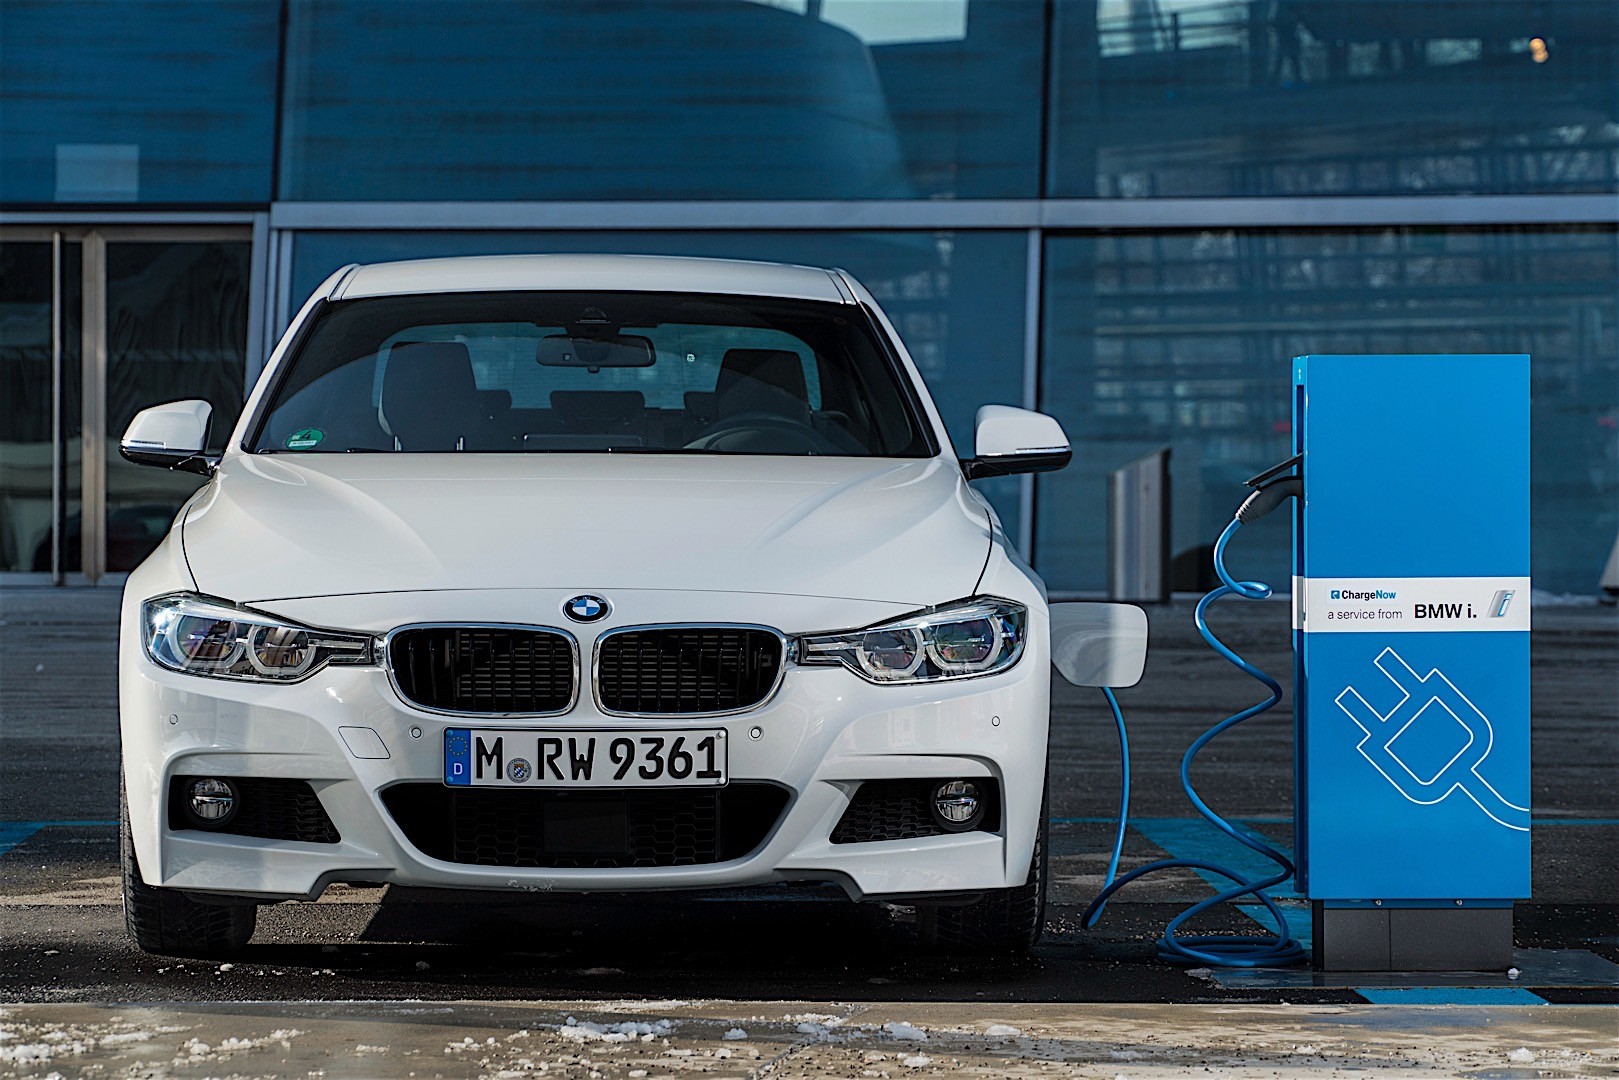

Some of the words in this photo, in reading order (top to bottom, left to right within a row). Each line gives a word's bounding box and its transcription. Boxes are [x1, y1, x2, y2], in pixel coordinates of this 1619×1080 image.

[1341, 590, 1396, 601] ChargeNow
[1327, 611, 1334, 620] a
[1337, 608, 1374, 620] service
[1378, 608, 1402, 620] from
[1414, 603, 1463, 619] BMW
[475, 736, 504, 780] M
[537, 737, 596, 780] RW
[609, 736, 722, 780] 9361
[453, 762, 463, 775] D
